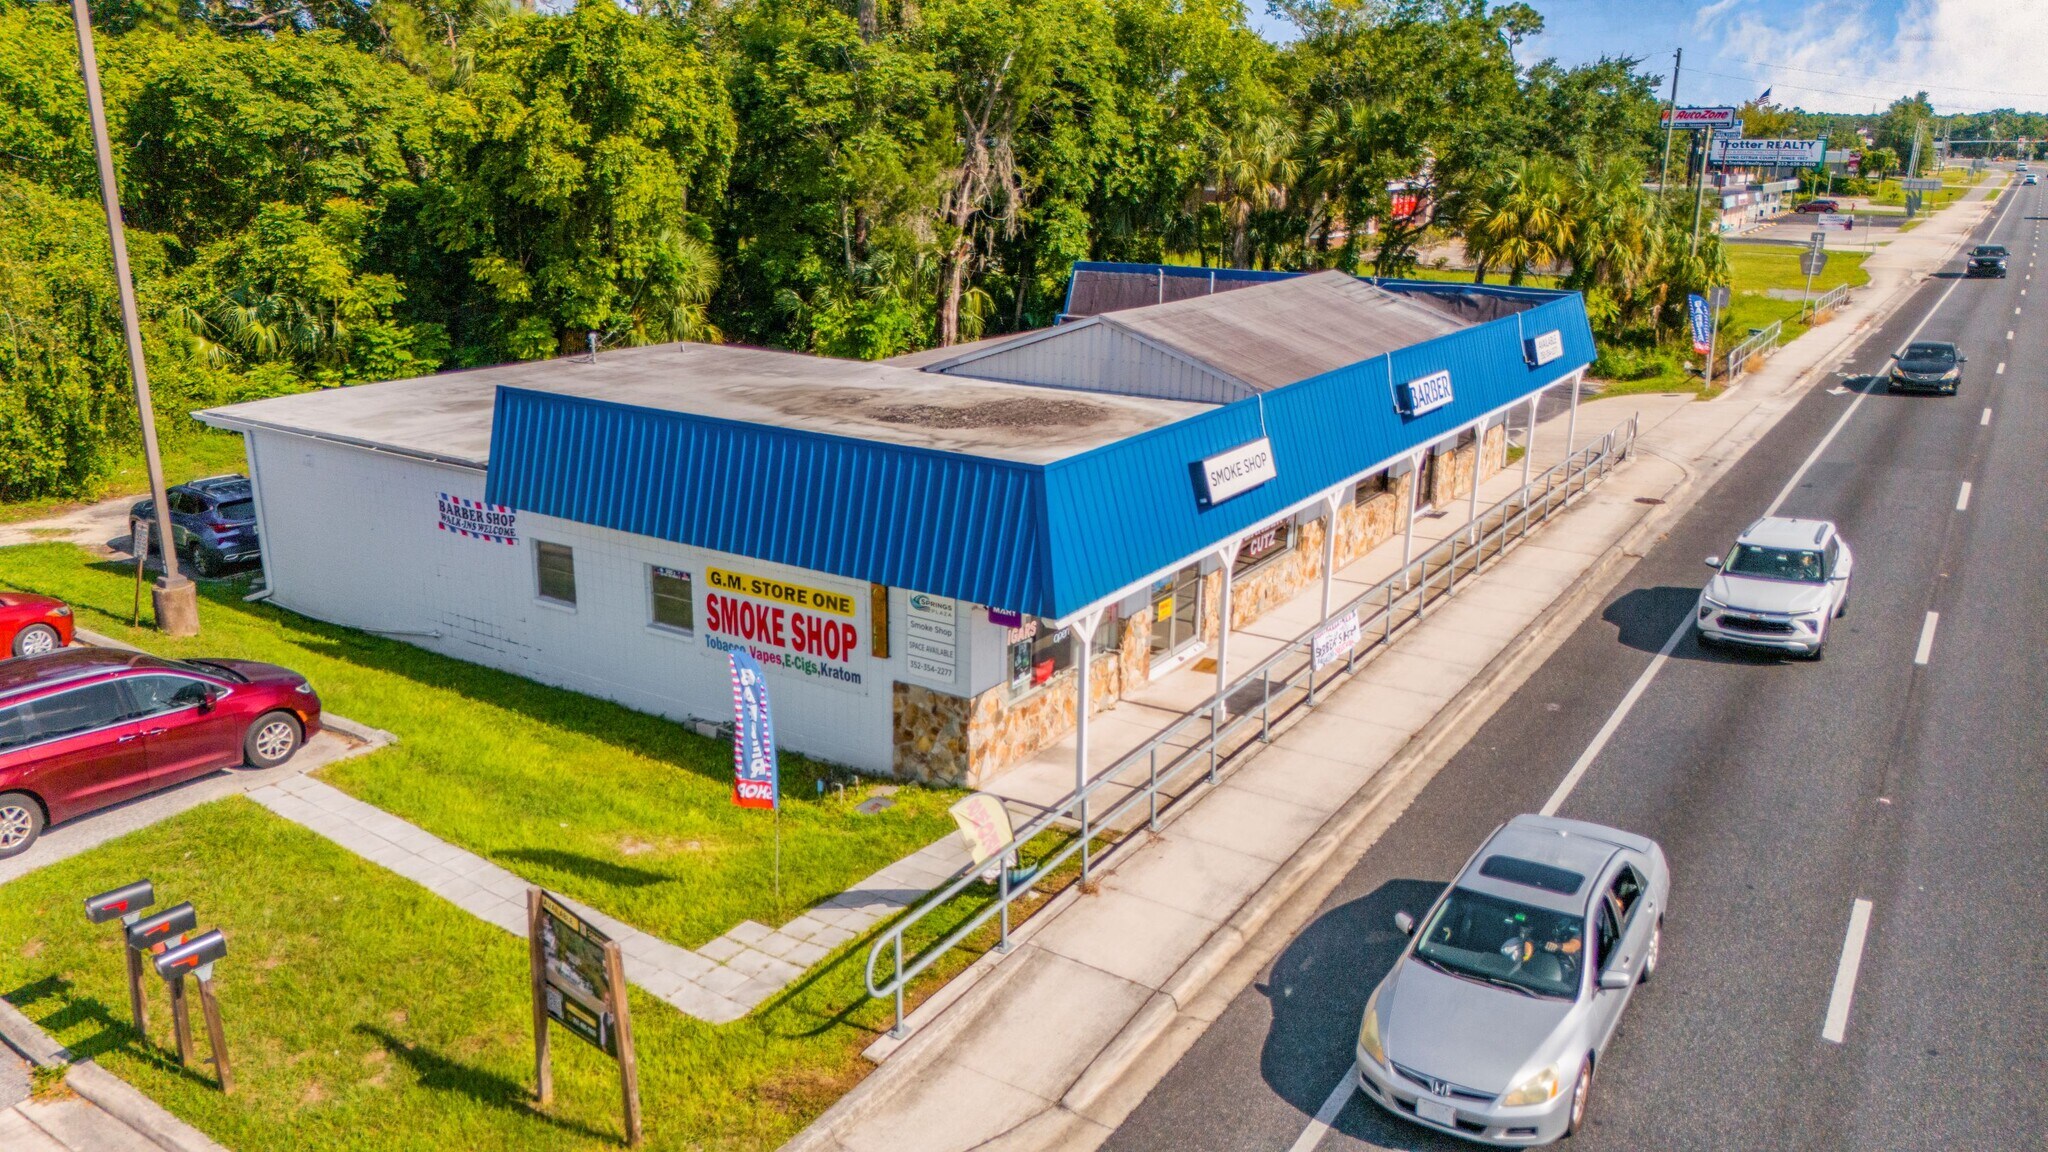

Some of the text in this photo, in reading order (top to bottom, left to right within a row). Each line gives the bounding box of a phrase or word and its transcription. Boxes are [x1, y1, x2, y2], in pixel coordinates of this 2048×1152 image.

[1675, 110, 1729, 119] AutoZone
[1719, 141, 1816, 150] Trotter REALTY
[1410, 376, 1450, 409] BARBER
[1211, 452, 1267, 487] SMOKE SHOP
[438, 500, 515, 527] BARBER SHOP
[440, 513, 516, 537] WALK-INS WELCOME
[1250, 530, 1276, 555] CUTZ
[710, 571, 746, 591] G.M.
[751, 580, 808, 604] STORE
[812, 592, 850, 613] ONE
[920, 598, 952, 611] SPRINGS
[930, 608, 952, 617] PLAZA
[706, 593, 858, 663] SMOKE SHOP
[910, 620, 952, 637] Smoke Shop
[1053, 628, 1070, 643] open
[909, 641, 953, 658] SPACE AVAILABLE
[910, 660, 952, 676] 352-354-2277
